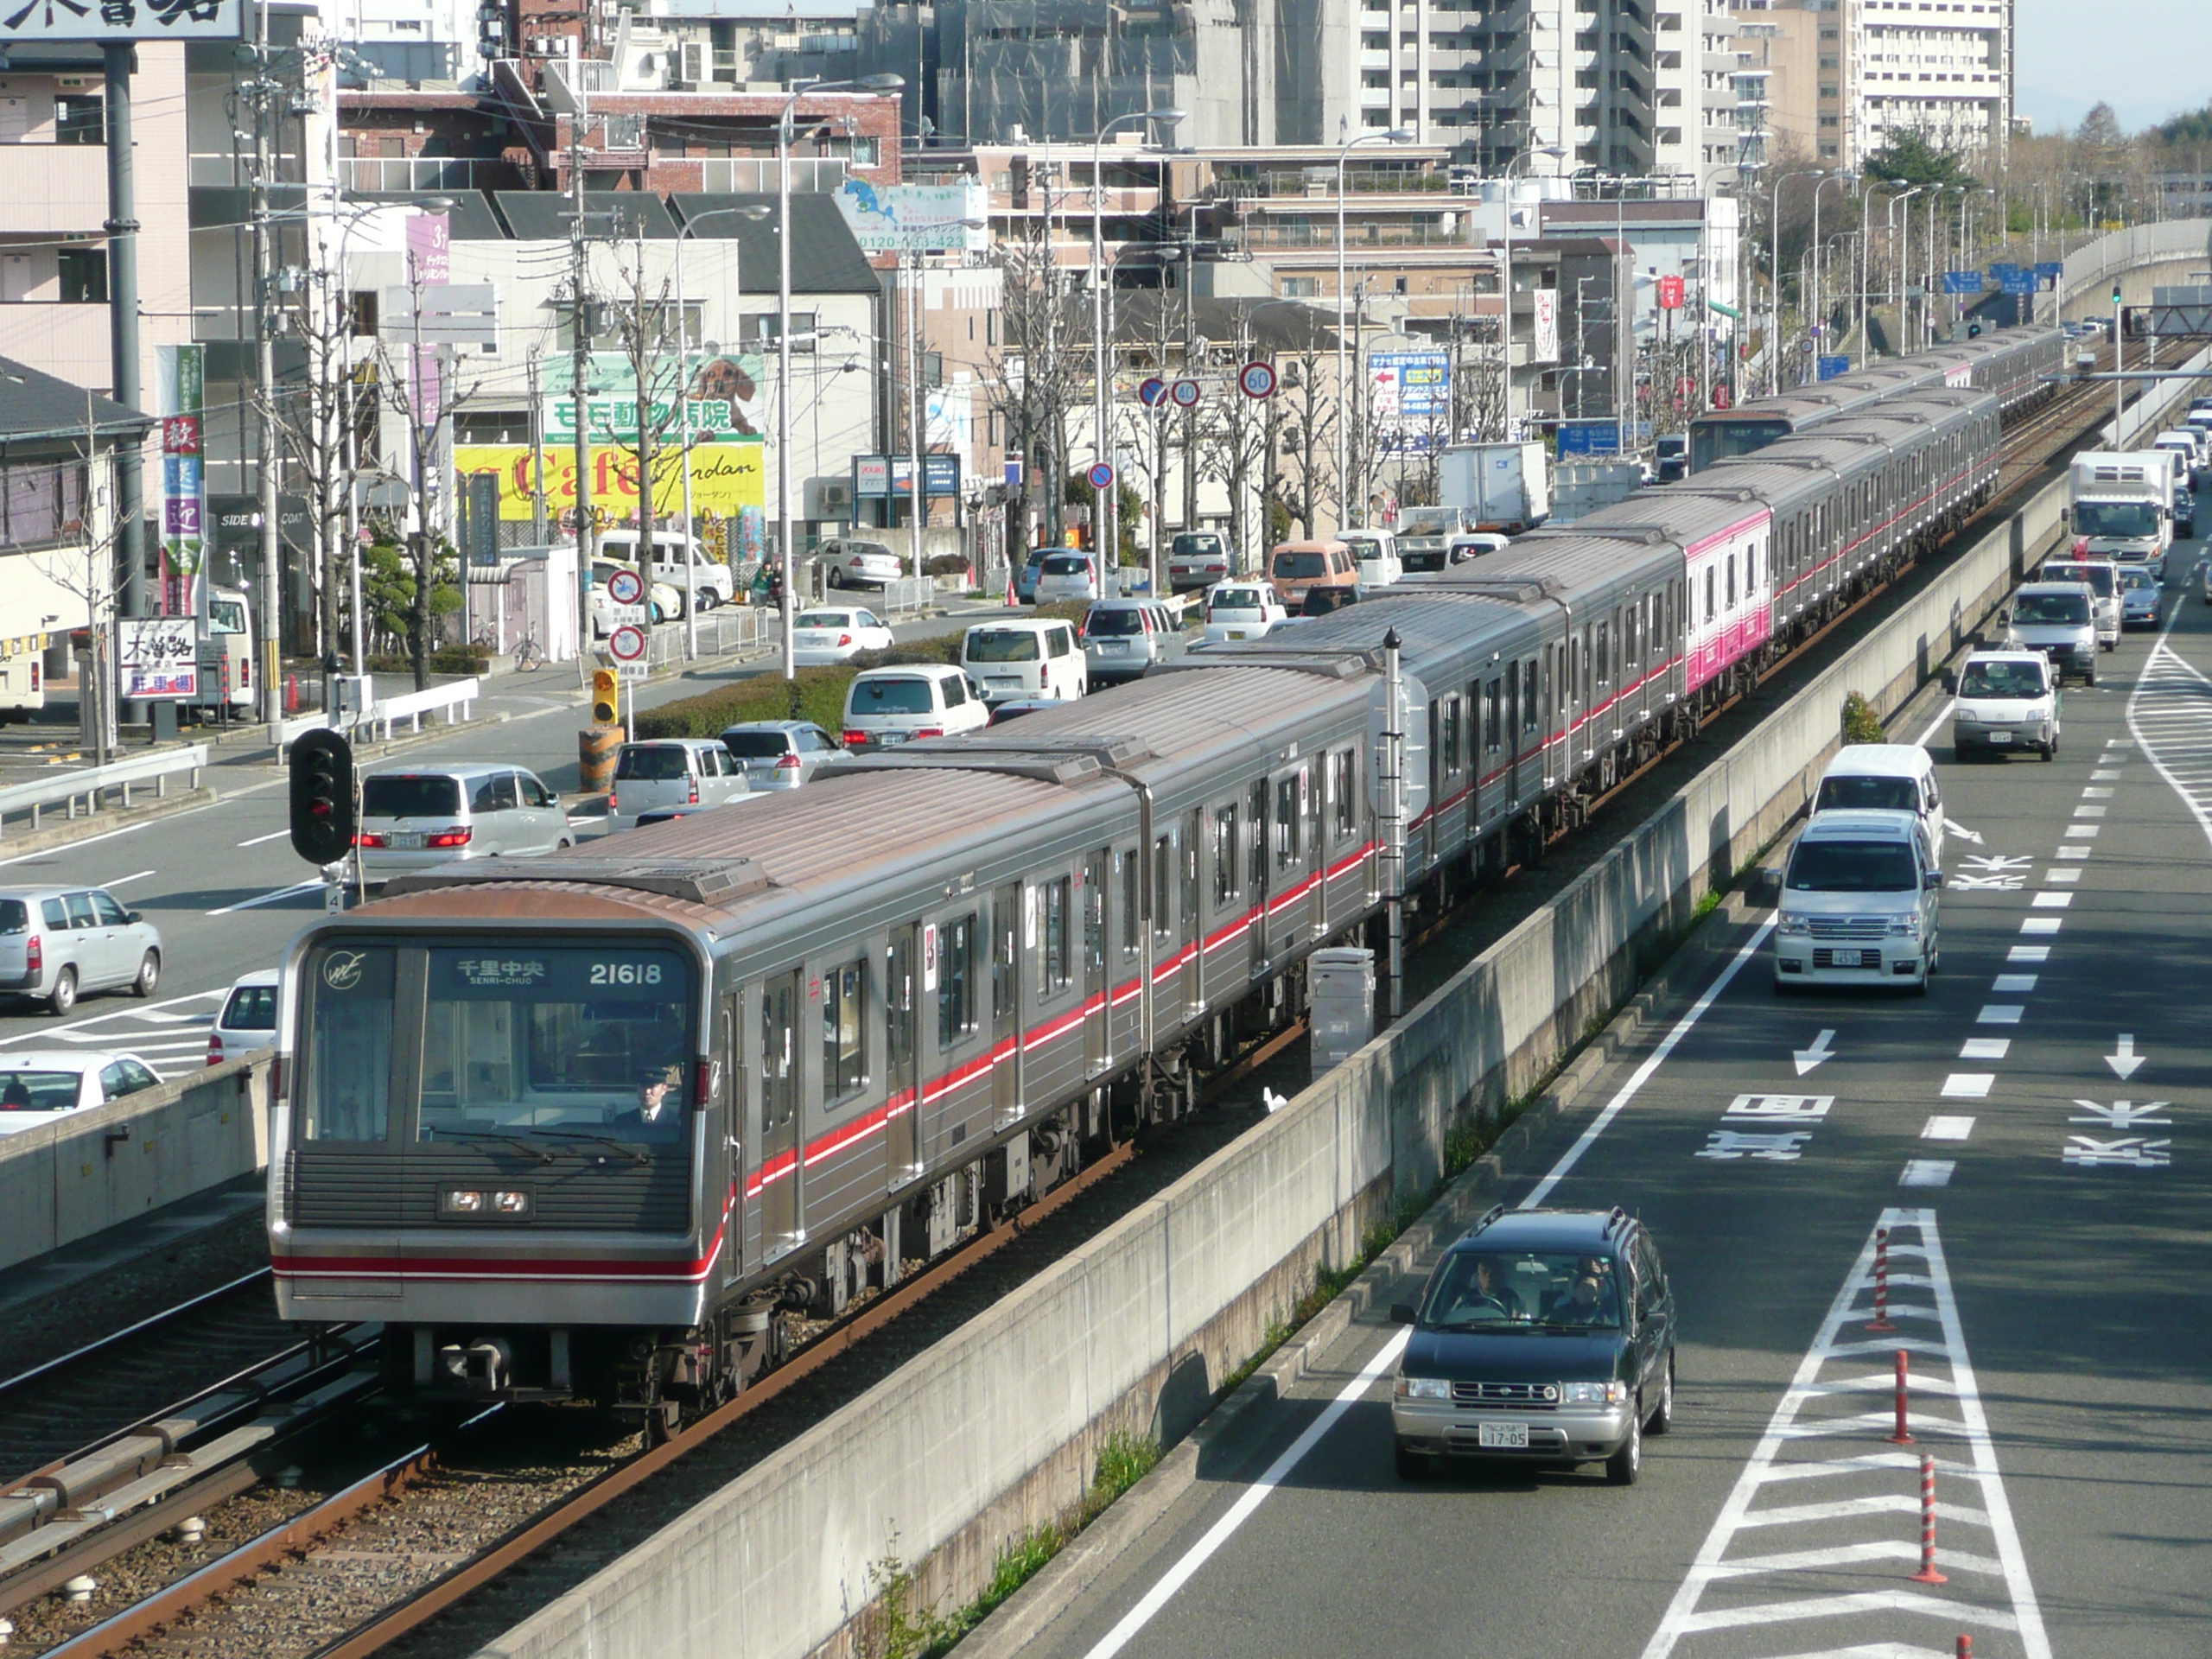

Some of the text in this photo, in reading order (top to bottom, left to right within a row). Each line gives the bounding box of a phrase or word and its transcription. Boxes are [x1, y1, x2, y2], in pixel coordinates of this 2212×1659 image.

[1247, 372, 1269, 389] 60
[1177, 386, 1195, 400] 40
[221, 514, 249, 526] SIDE
[281, 512, 303, 524] COAT
[131, 674, 191, 692] 駐車場
[457, 960, 545, 977] 千里中央
[590, 963, 662, 985] 21618
[1491, 1432, 1526, 1446] 17-05
